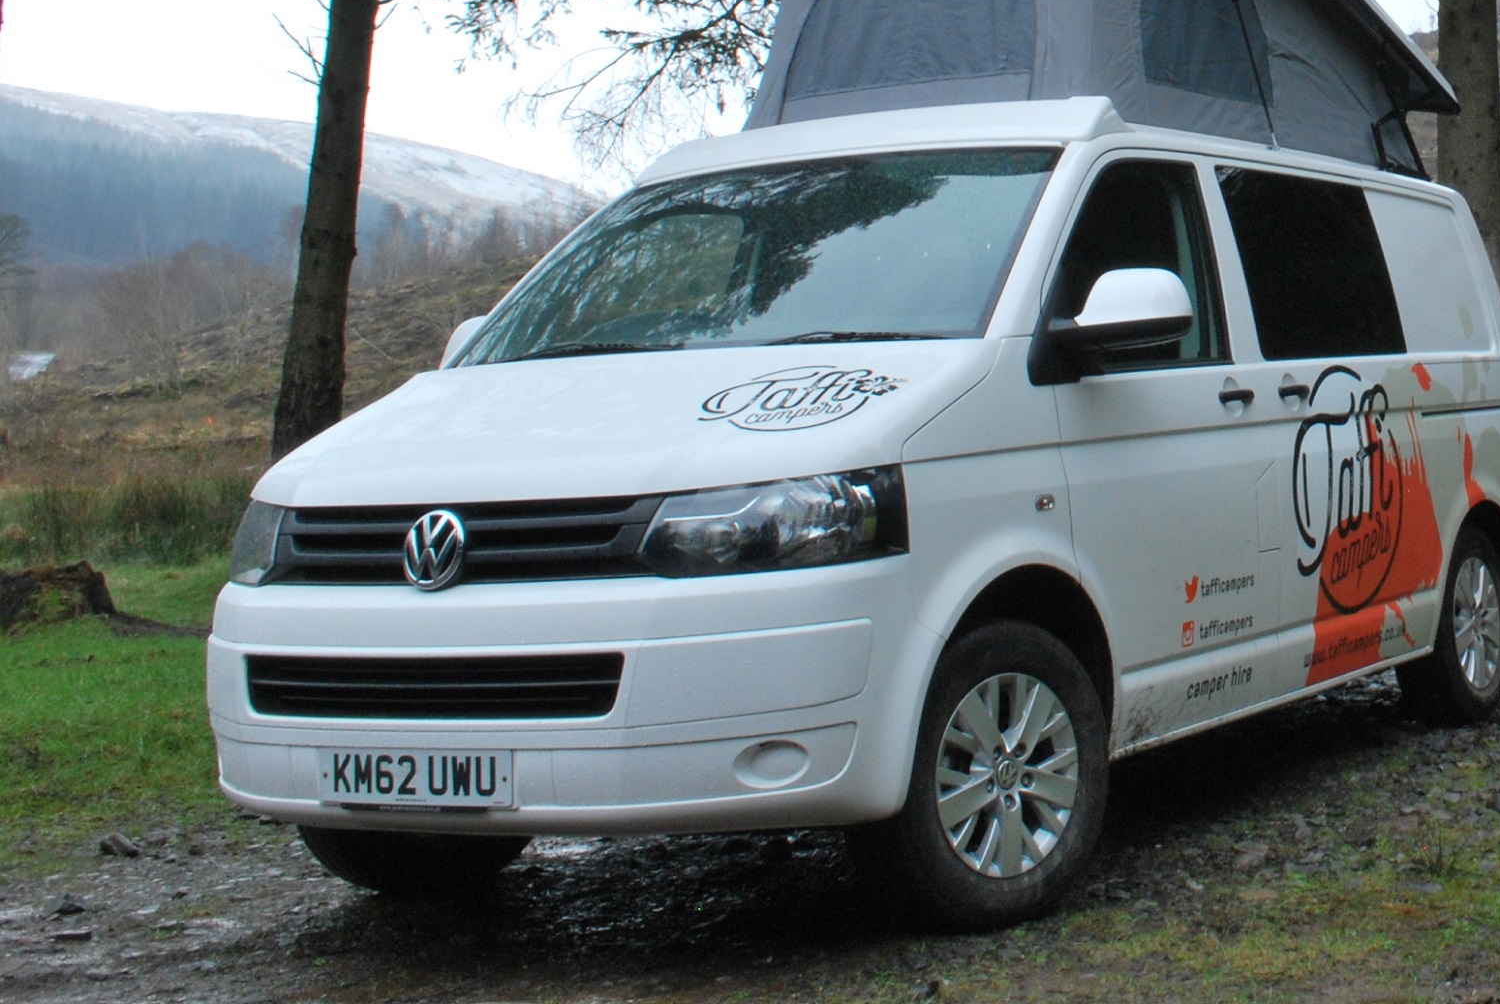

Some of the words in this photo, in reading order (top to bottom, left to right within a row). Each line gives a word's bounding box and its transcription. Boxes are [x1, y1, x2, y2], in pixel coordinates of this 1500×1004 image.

[698, 369, 873, 421] Taffi
[744, 401, 844, 424] campers
[1331, 512, 1391, 590] campers
[1201, 575, 1255, 597] tafficampers
[1199, 616, 1253, 639] tafficampers
[1187, 673, 1229, 700] camper
[1230, 665, 1253, 686] hire
[333, 753, 417, 795] KM62
[428, 755, 497, 797] UWU
